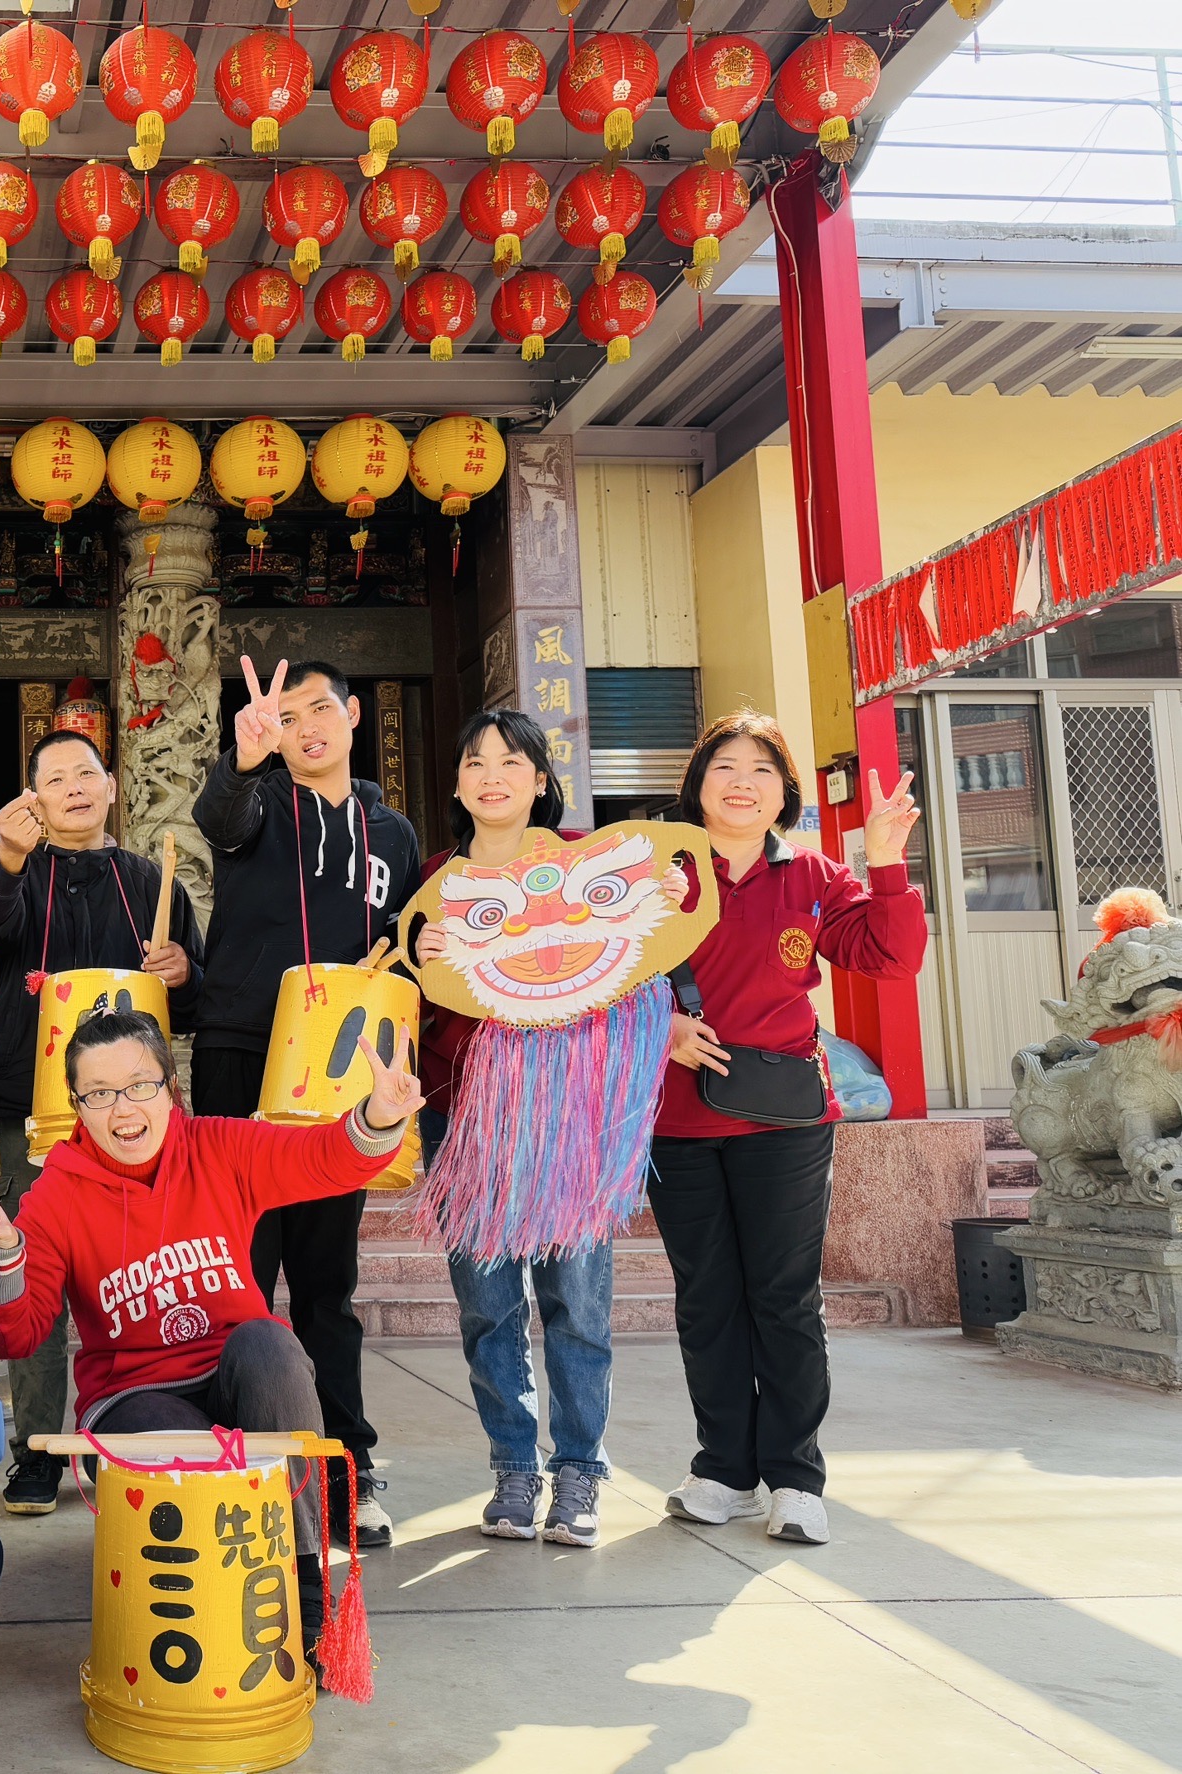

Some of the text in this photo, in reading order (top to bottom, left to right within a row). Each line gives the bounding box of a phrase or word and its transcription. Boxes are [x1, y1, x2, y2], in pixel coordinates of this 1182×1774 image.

[51, 426, 74, 482] 清水祖師
[150, 426, 174, 482] 清水祖師
[256, 423, 280, 478] 清水祖師
[364, 422, 388, 477] 清水祖師
[464, 420, 487, 476] 清水祖師
[364, 853, 391, 909] B
[98, 1236, 234, 1314] CROCODILE
[108, 1267, 246, 1339] JUNIOR
[140, 1500, 296, 1692] 讚
